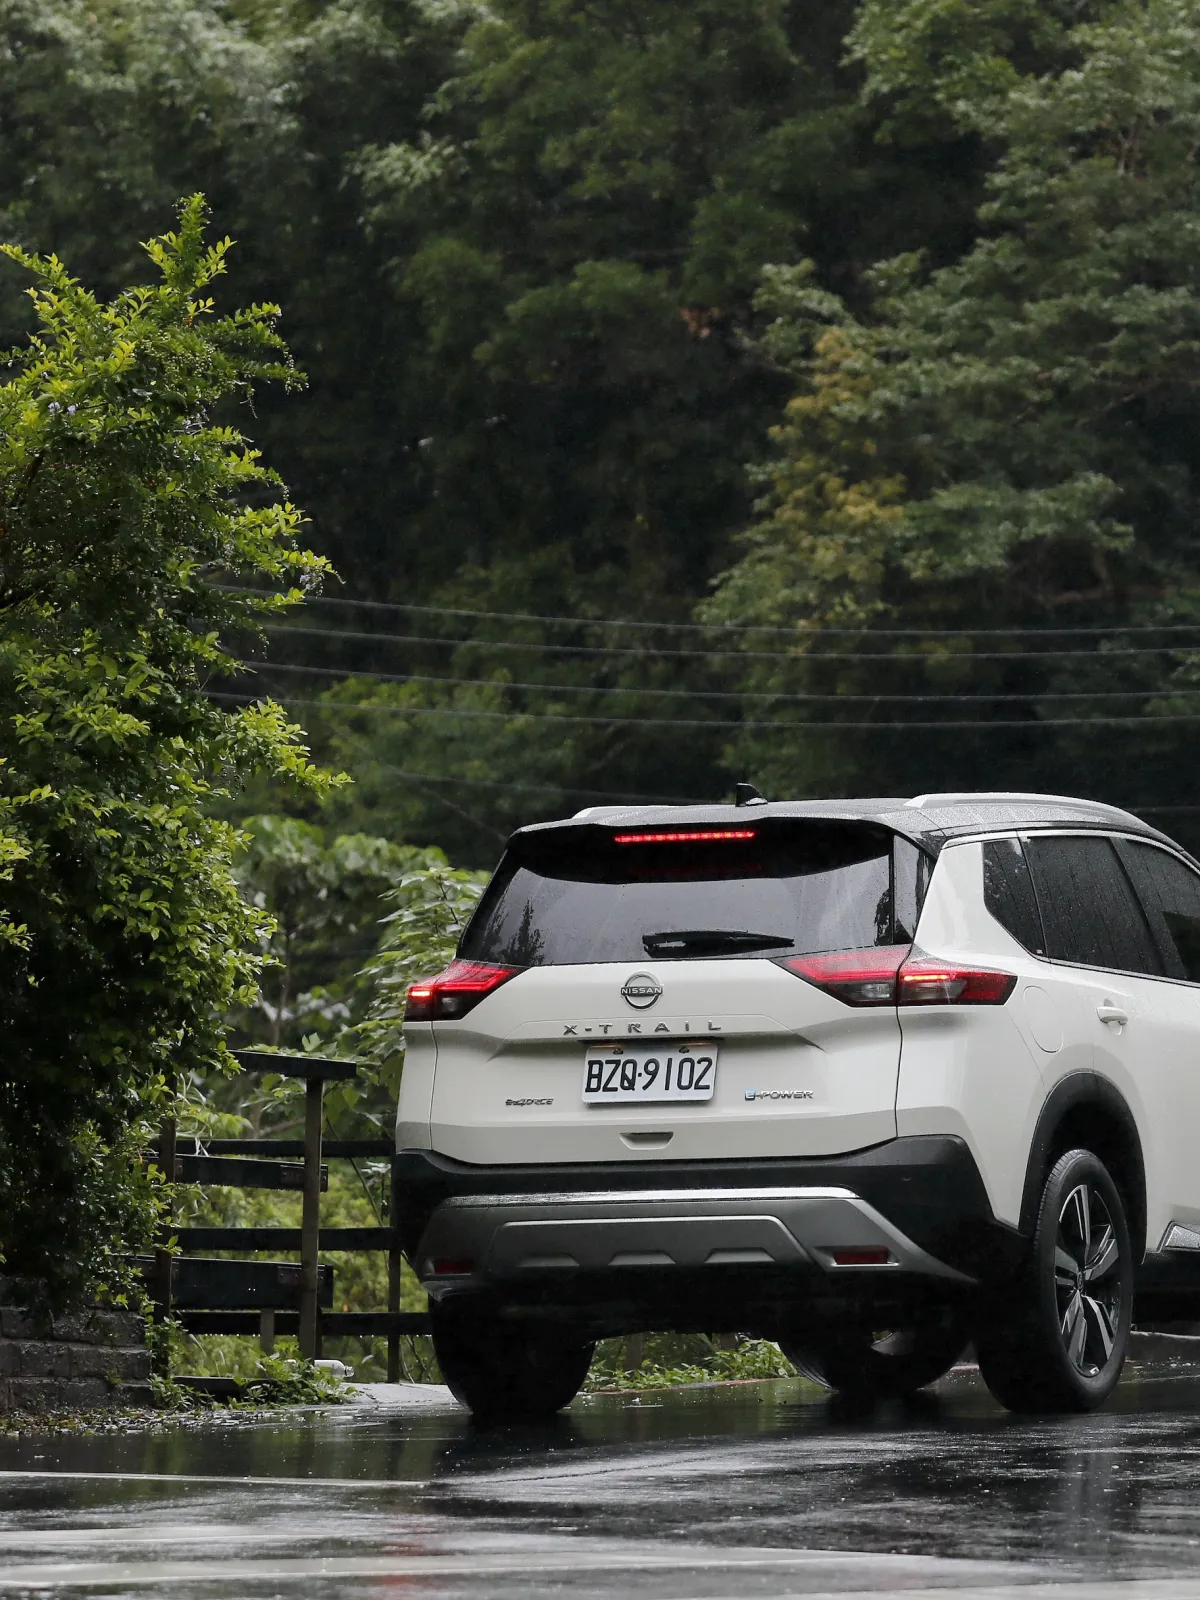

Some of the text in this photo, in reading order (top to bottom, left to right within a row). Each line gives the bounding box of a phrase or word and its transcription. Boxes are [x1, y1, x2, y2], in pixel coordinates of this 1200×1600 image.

[621, 986, 663, 995] NISSAN
[563, 1020, 722, 1035] X-TRAIL
[585, 1057, 713, 1092] BZQ-9102
